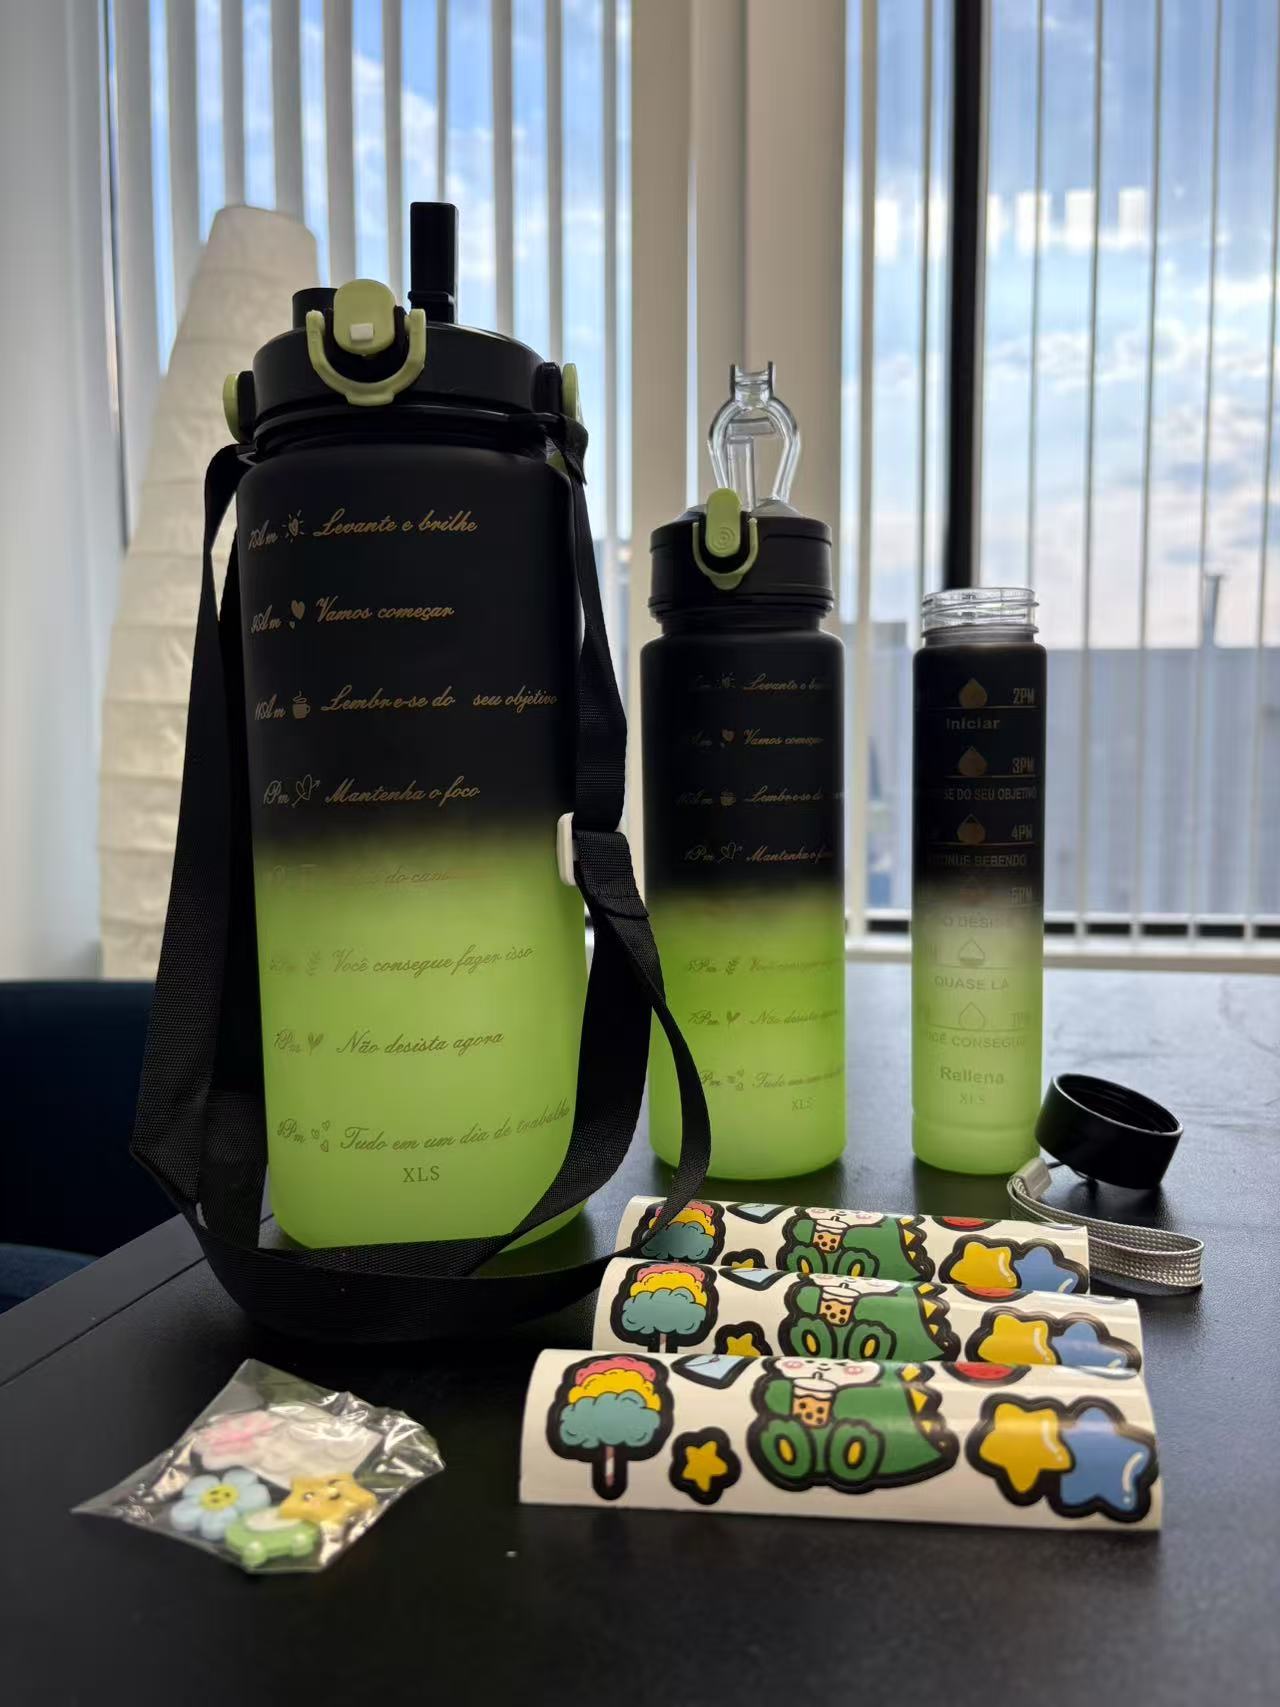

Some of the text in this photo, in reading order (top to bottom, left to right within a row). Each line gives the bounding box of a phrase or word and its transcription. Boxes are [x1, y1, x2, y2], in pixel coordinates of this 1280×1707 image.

[313, 508, 397, 536] Levante
[401, 521, 413, 532] e
[419, 510, 479, 533] brilhe
[316, 596, 372, 622] Vamos
[377, 606, 455, 623] começar
[431, 686, 456, 708] do
[473, 693, 502, 707] seu
[505, 685, 557, 713] objetivo
[1013, 688, 1035, 705] 2PM
[946, 717, 1001, 730] Iniciar
[1012, 757, 1034, 774] 3PM
[325, 778, 425, 804] Mantenha
[439, 775, 480, 807] foco
[957, 788, 972, 800] DO
[974, 787, 995, 800] SEU
[1011, 825, 1033, 841] 4PM
[332, 949, 367, 973] Você
[373, 957, 452, 978] consegue
[450, 944, 503, 975] fazer
[505, 945, 536, 960] isso
[935, 976, 986, 991] QUASE
[336, 1030, 380, 1054] Não
[384, 1033, 448, 1054] desista
[452, 1032, 505, 1056] agora
[940, 1066, 1004, 1085] Rellena
[340, 1126, 388, 1151] Tudo
[392, 1138, 420, 1151] em
[424, 1134, 455, 1149] um
[459, 1122, 489, 1145] dia
[493, 1116, 513, 1140] de
[402, 1165, 440, 1182] XLS
